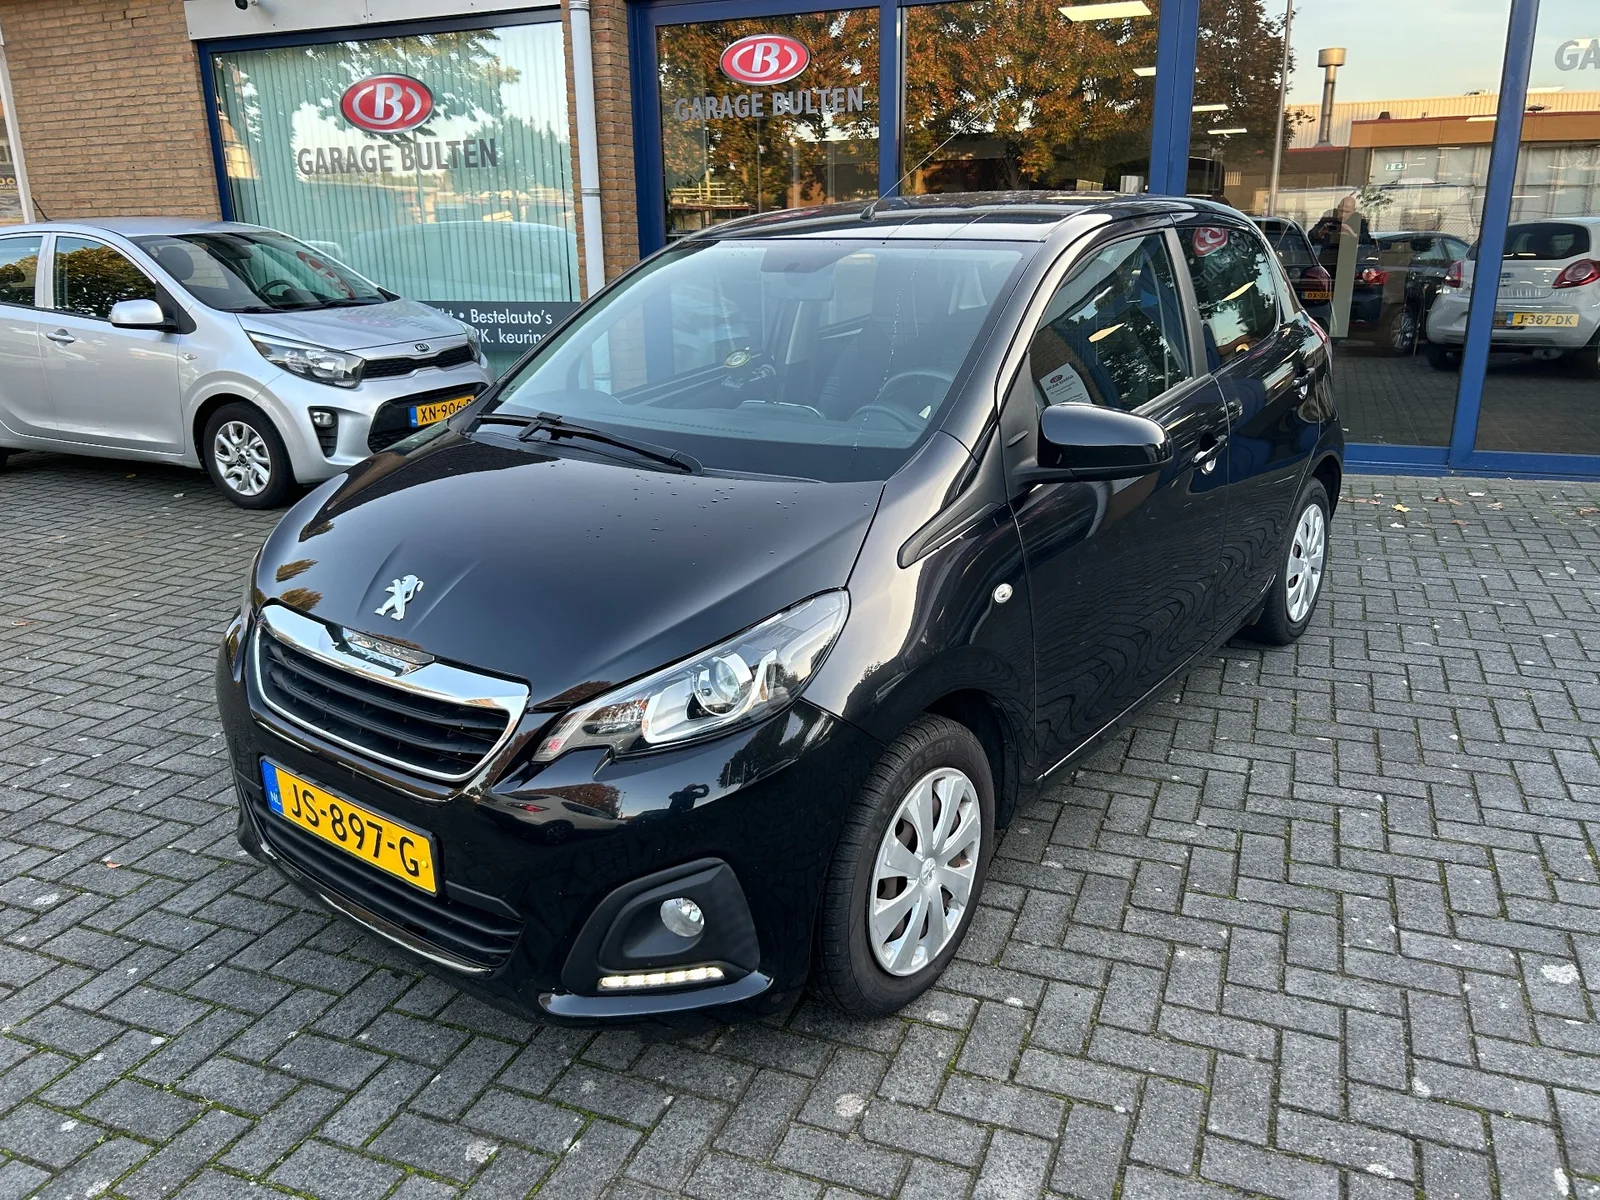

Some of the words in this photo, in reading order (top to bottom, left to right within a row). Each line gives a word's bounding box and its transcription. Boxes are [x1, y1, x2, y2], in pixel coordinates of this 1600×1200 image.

[674, 93, 765, 121] GARAGE
[772, 87, 864, 116] BULTEN
[297, 144, 393, 176] GARAGE
[400, 138, 498, 171] BULTEN
[498, 328, 548, 345] keurin
[1517, 314, 1573, 325] J-387-DK
[891, 738, 956, 800] SEASON
[270, 791, 281, 805] NL
[291, 783, 420, 878] JS-897-G
